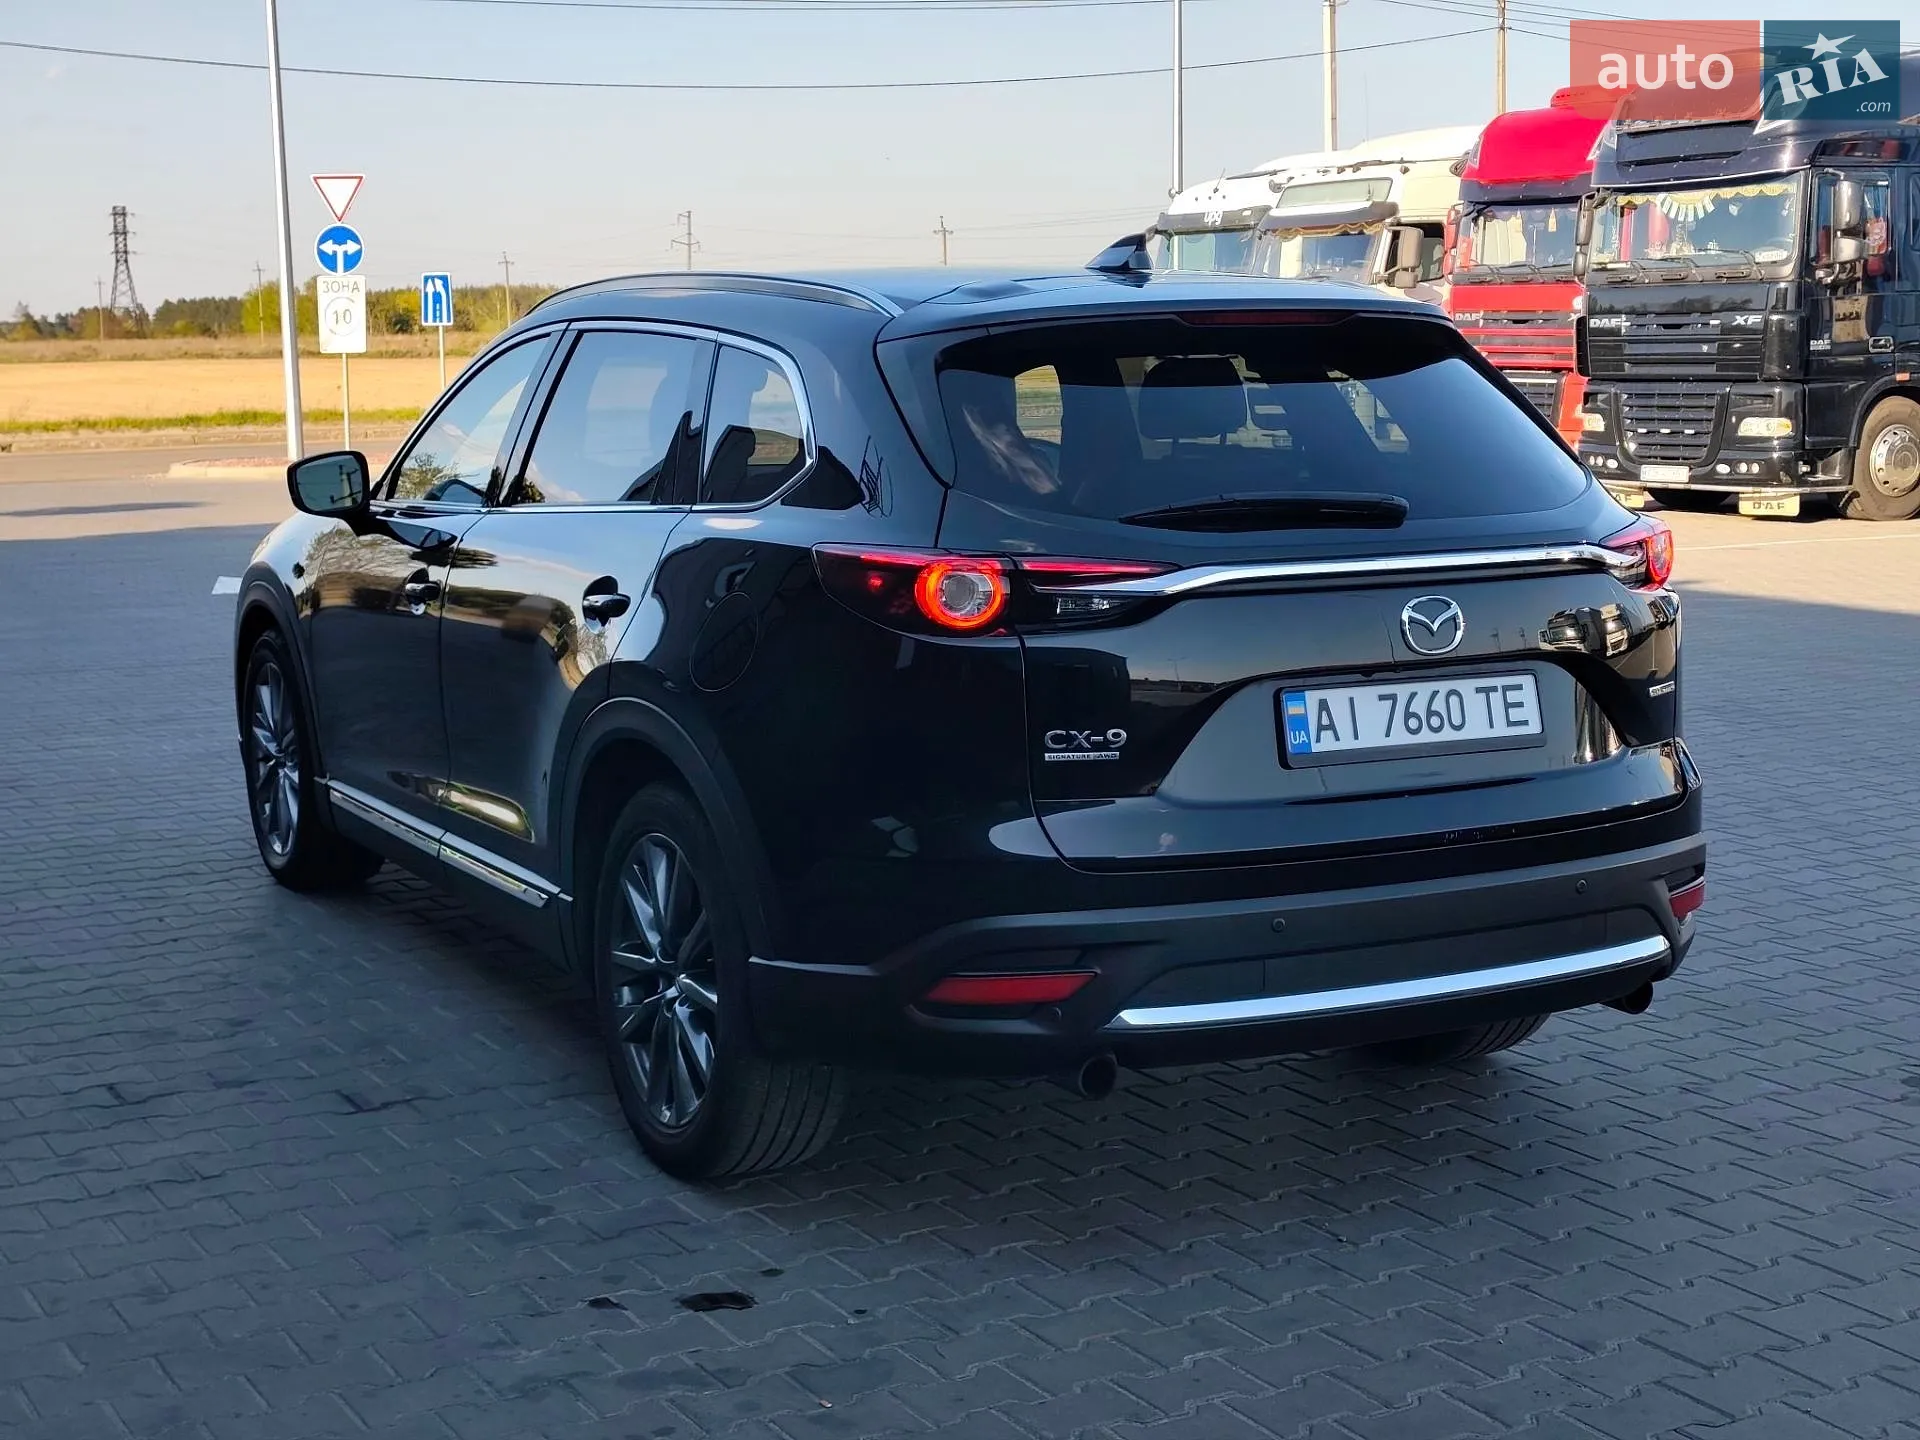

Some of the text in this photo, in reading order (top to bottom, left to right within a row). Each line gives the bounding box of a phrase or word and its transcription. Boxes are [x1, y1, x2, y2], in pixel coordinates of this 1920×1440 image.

[322, 280, 360, 294] ЗОНА
[332, 308, 352, 325] 10
[1454, 312, 1481, 321] DAF
[1589, 318, 1622, 328] DAF
[1731, 315, 1763, 326] XF
[1752, 501, 1785, 510] DAF
[1315, 683, 1530, 744] AI 7660 TE
[1044, 728, 1127, 749] CX-9
[1291, 730, 1308, 745] UA
